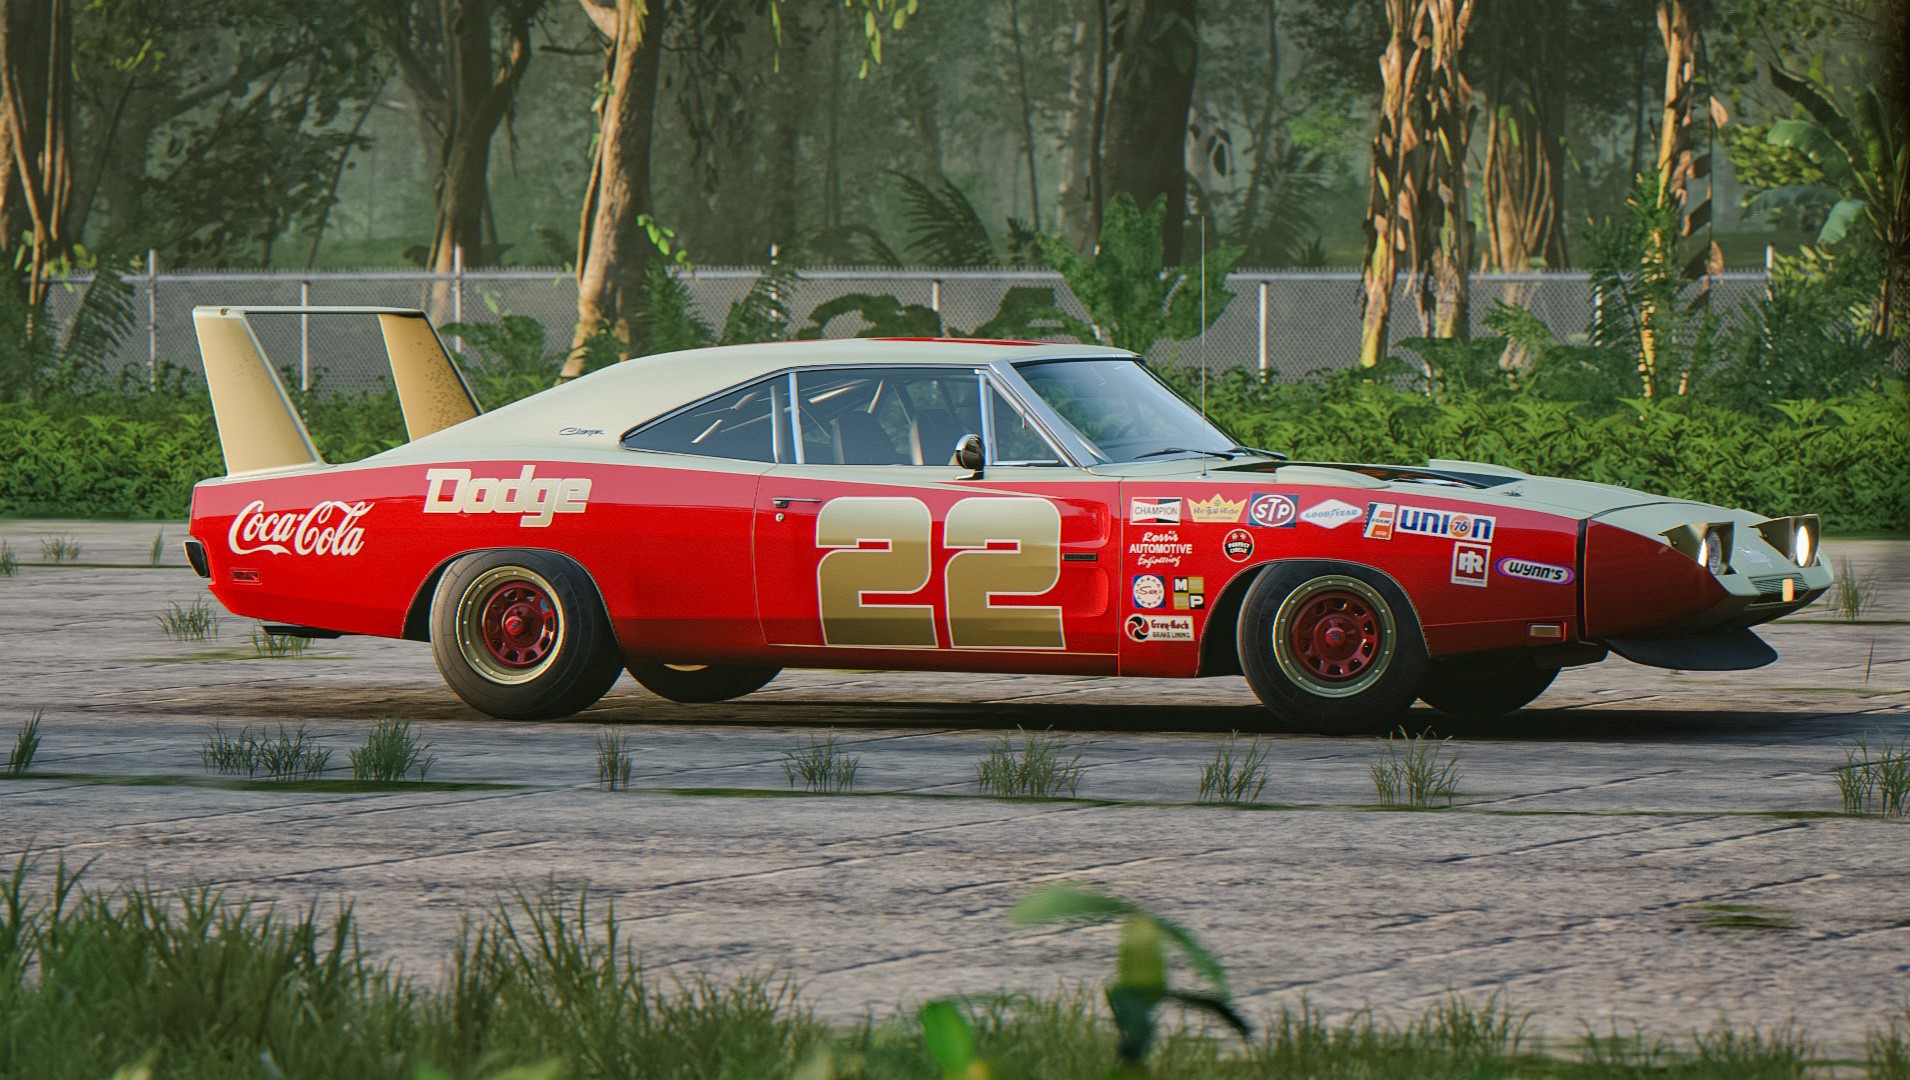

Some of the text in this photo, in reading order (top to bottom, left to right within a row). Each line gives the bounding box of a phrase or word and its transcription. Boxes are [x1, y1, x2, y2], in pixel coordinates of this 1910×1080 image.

[423, 465, 593, 528] Dodge
[1135, 506, 1178, 515] CHAMPION
[1255, 497, 1290, 522] STP
[1305, 507, 1358, 518] GOODYEAR
[228, 500, 375, 556] Coca-Cola
[1453, 520, 1469, 532] 76
[1129, 543, 1193, 554] AUTOMOTIVE
[816, 496, 1067, 650] 22
